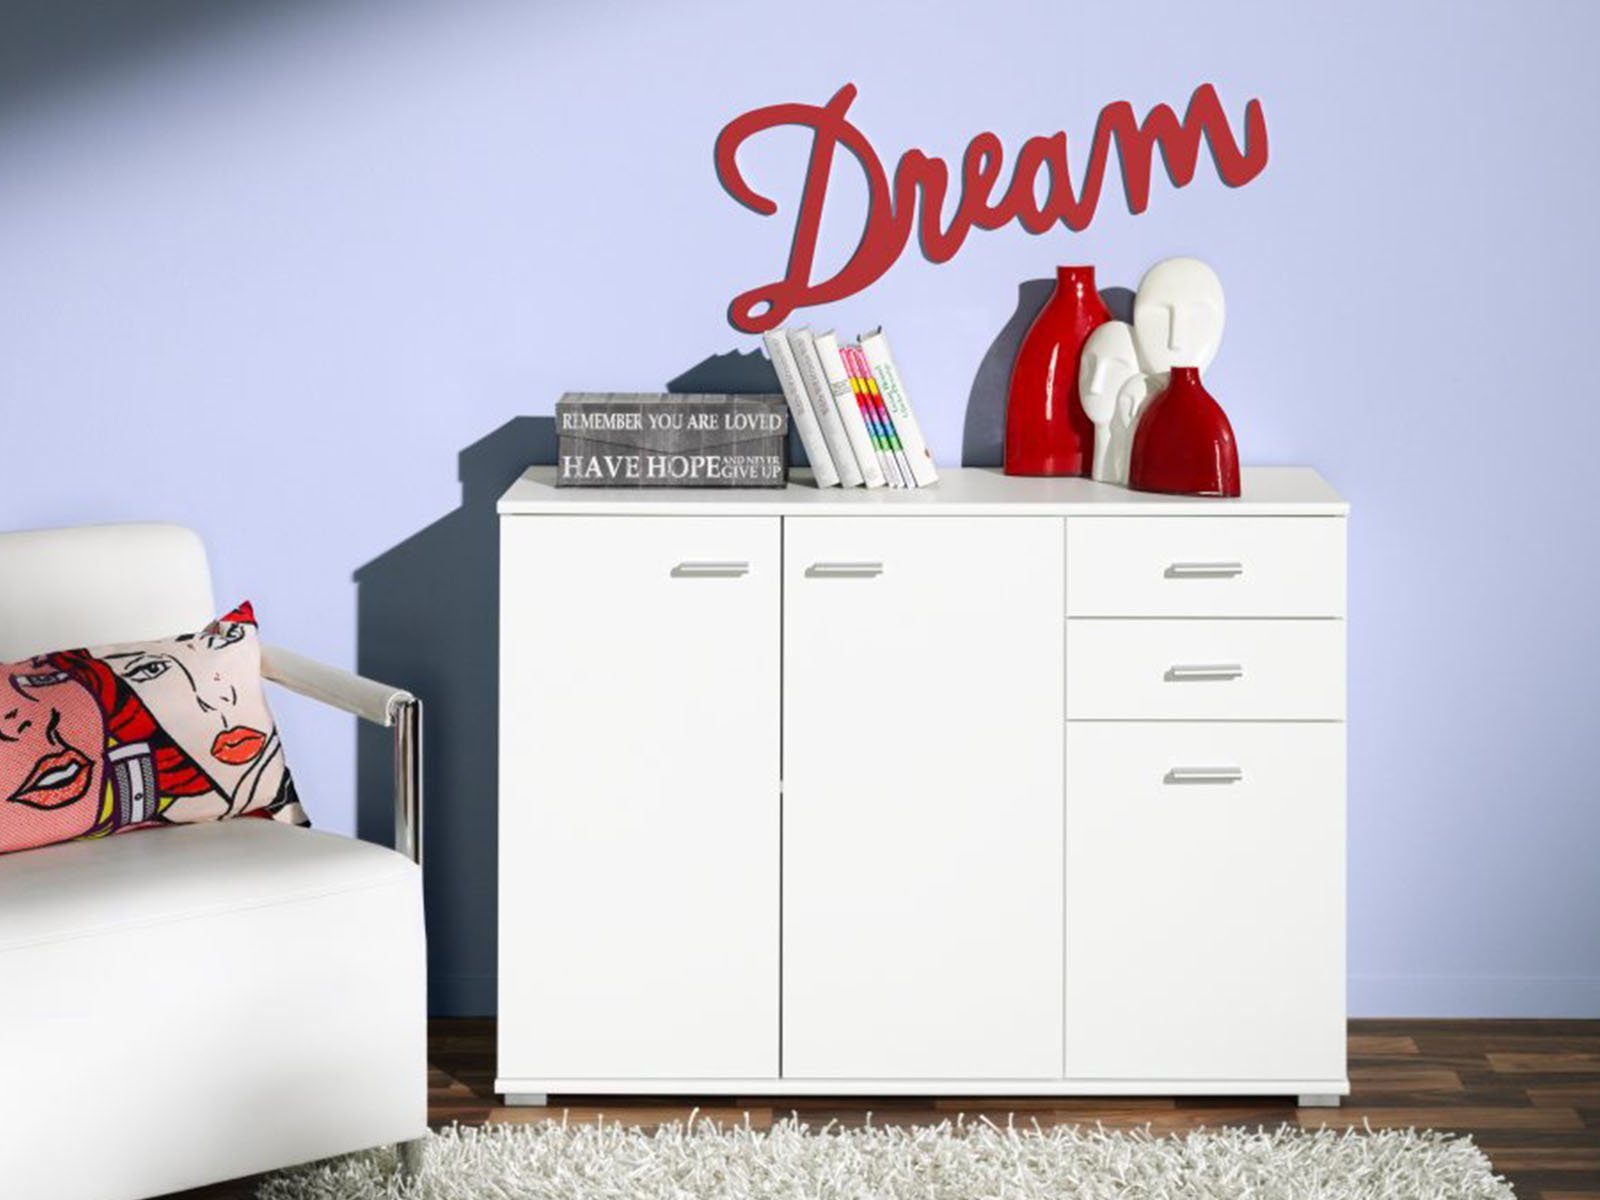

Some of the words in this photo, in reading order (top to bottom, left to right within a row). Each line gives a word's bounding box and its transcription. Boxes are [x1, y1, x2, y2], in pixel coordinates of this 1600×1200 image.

[714, 83, 1268, 334] Dream
[562, 413, 643, 430] REMEMBER
[648, 413, 682, 430] YOU
[687, 413, 719, 430] ARE
[724, 413, 782, 430] LOVED
[562, 455, 640, 479] HAVE
[646, 455, 721, 479] HOPE
[721, 456, 744, 466] AND
[746, 456, 780, 466] NEVER
[720, 466, 758, 479] GIVE
[761, 466, 781, 479] UP
